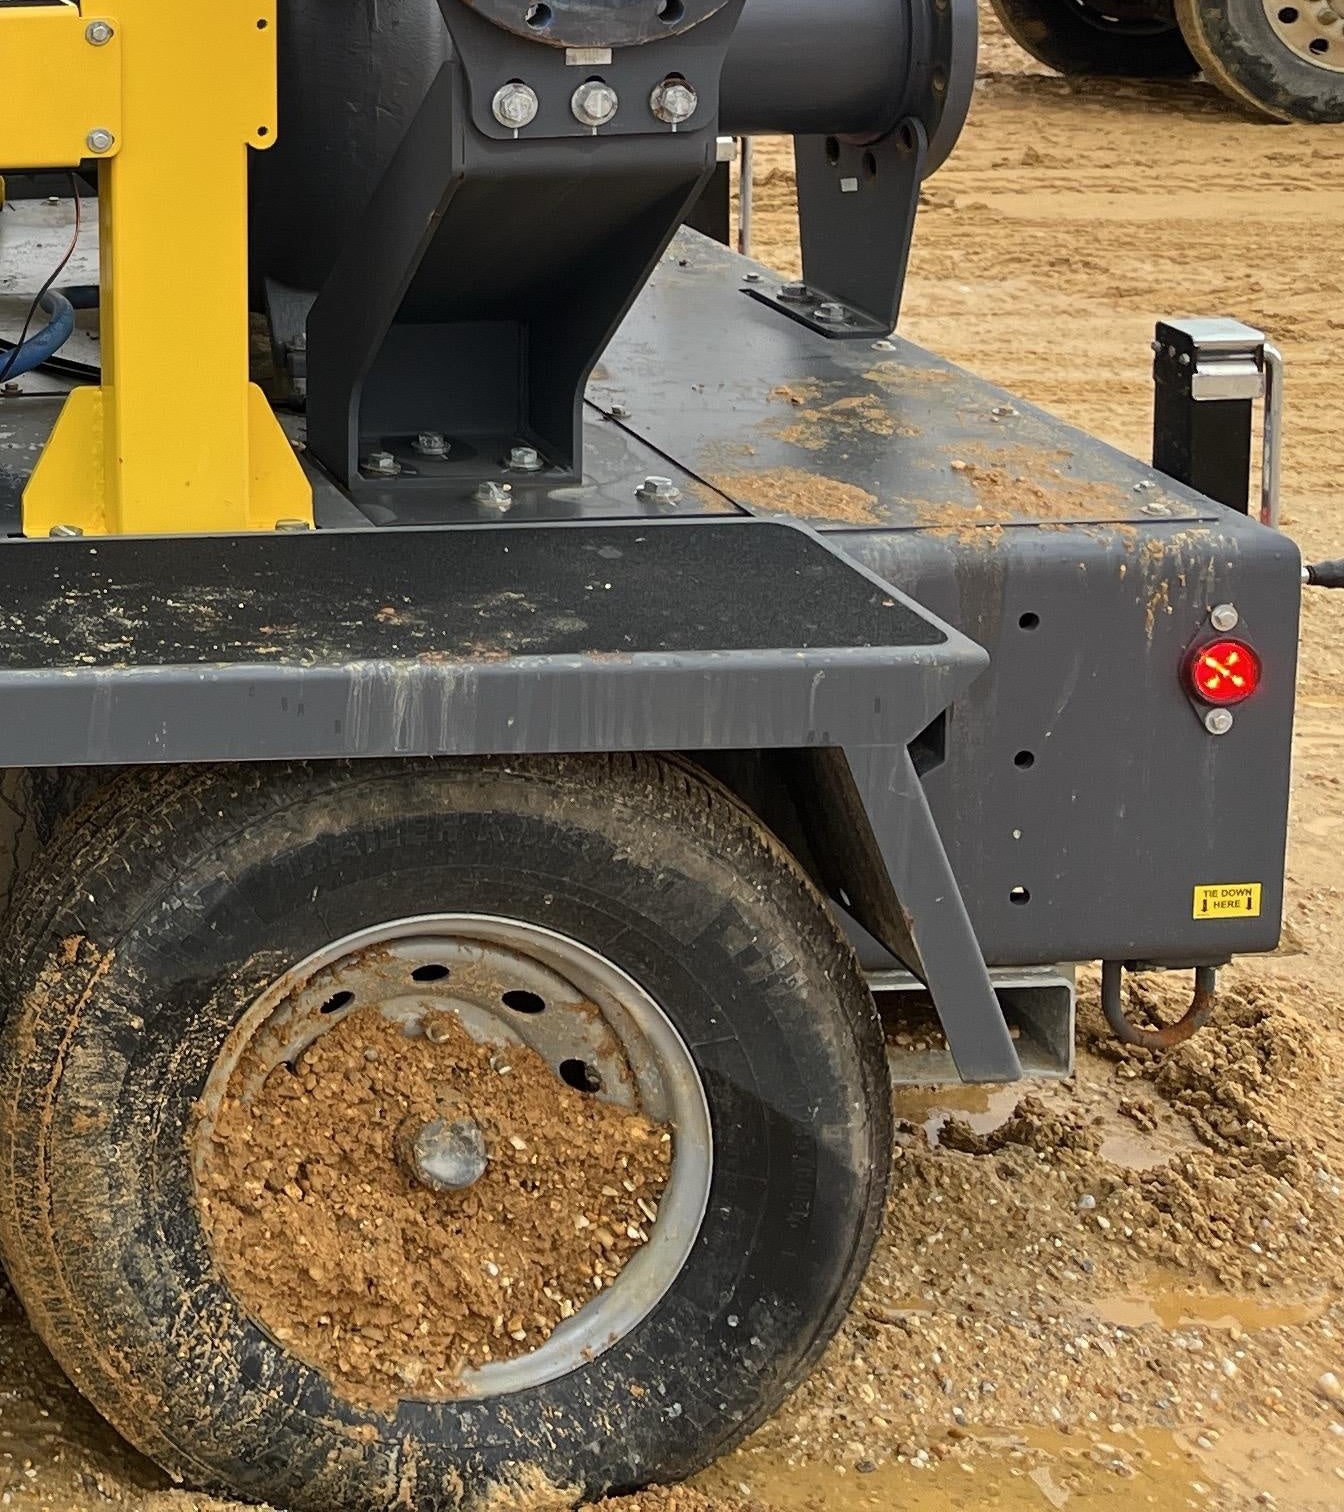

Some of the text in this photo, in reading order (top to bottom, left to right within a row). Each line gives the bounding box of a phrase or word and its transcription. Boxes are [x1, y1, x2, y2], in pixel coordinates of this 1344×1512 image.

[1203, 888, 1252, 898] TIE DOWN
[1213, 900, 1241, 909] HERE
